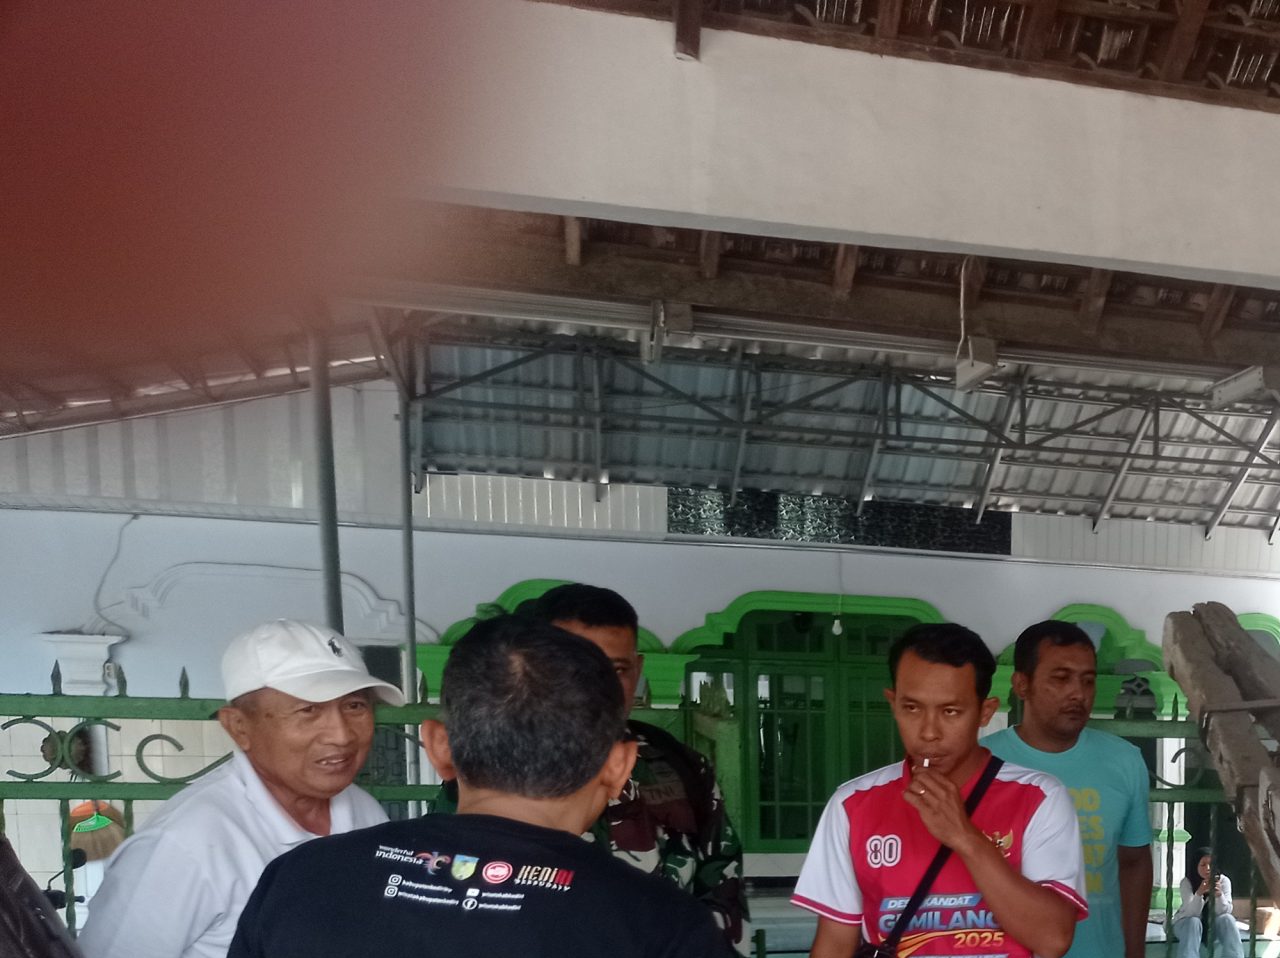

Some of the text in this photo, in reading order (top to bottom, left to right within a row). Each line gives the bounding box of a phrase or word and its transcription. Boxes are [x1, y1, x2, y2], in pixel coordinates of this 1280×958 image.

[866, 834, 901, 868] 80
[887, 899, 909, 909] DES
[879, 910, 999, 932] GMILAN
[954, 932, 1004, 949] 2025
